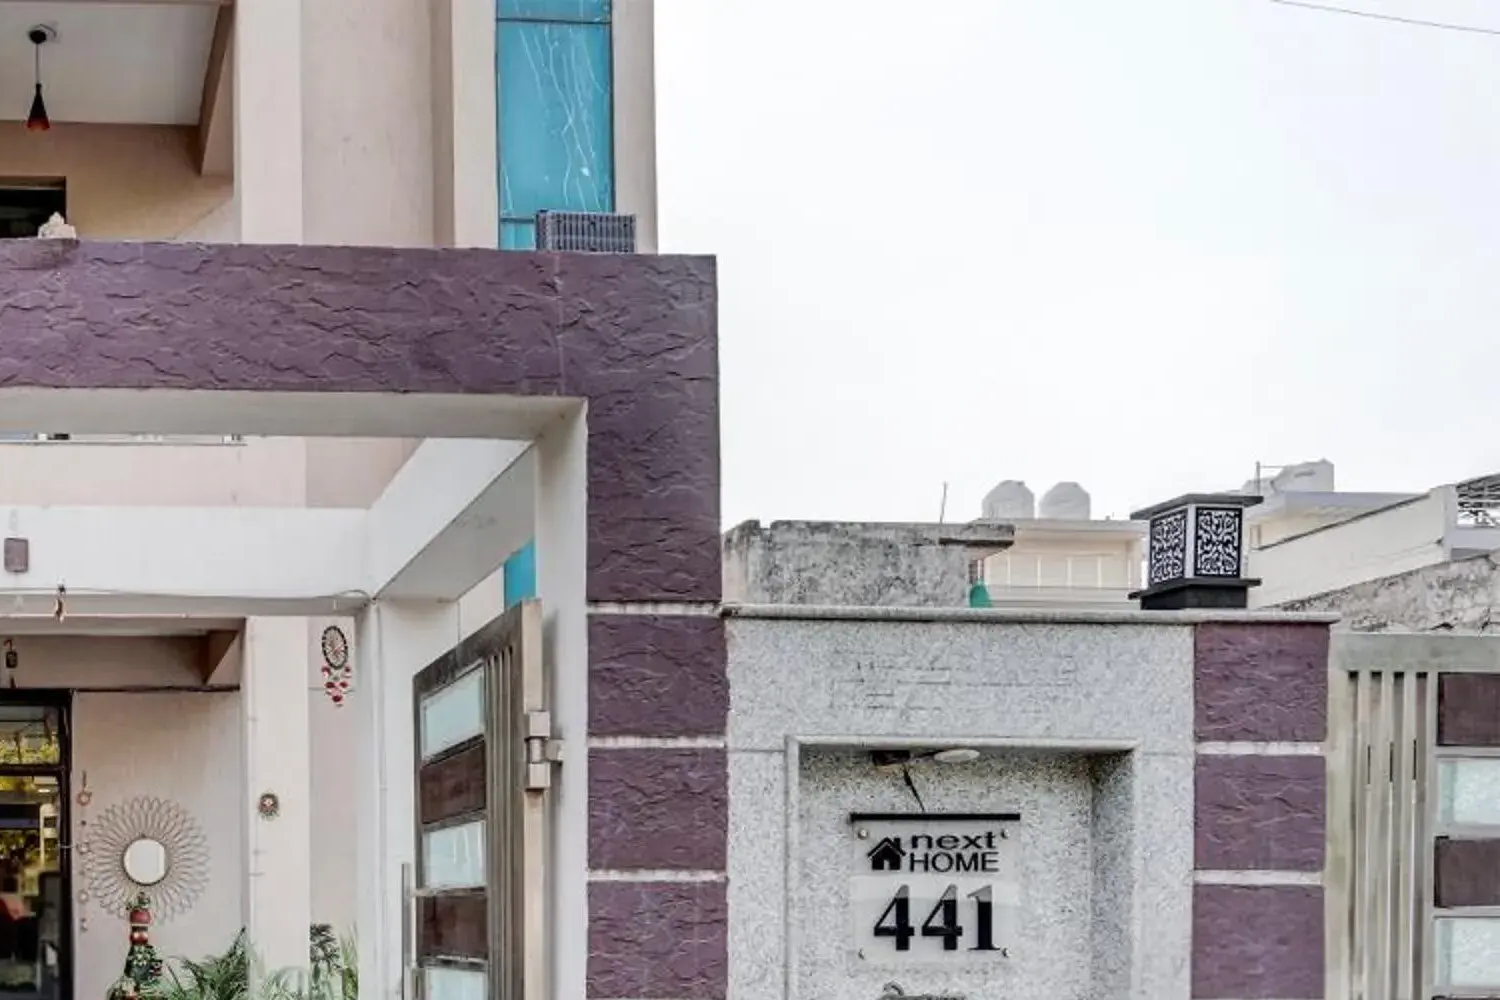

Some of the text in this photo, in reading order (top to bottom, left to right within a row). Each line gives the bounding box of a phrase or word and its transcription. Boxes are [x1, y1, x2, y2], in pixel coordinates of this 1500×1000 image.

[911, 831, 997, 850] next
[909, 851, 1000, 873] HOME
[873, 884, 1000, 951] 441
